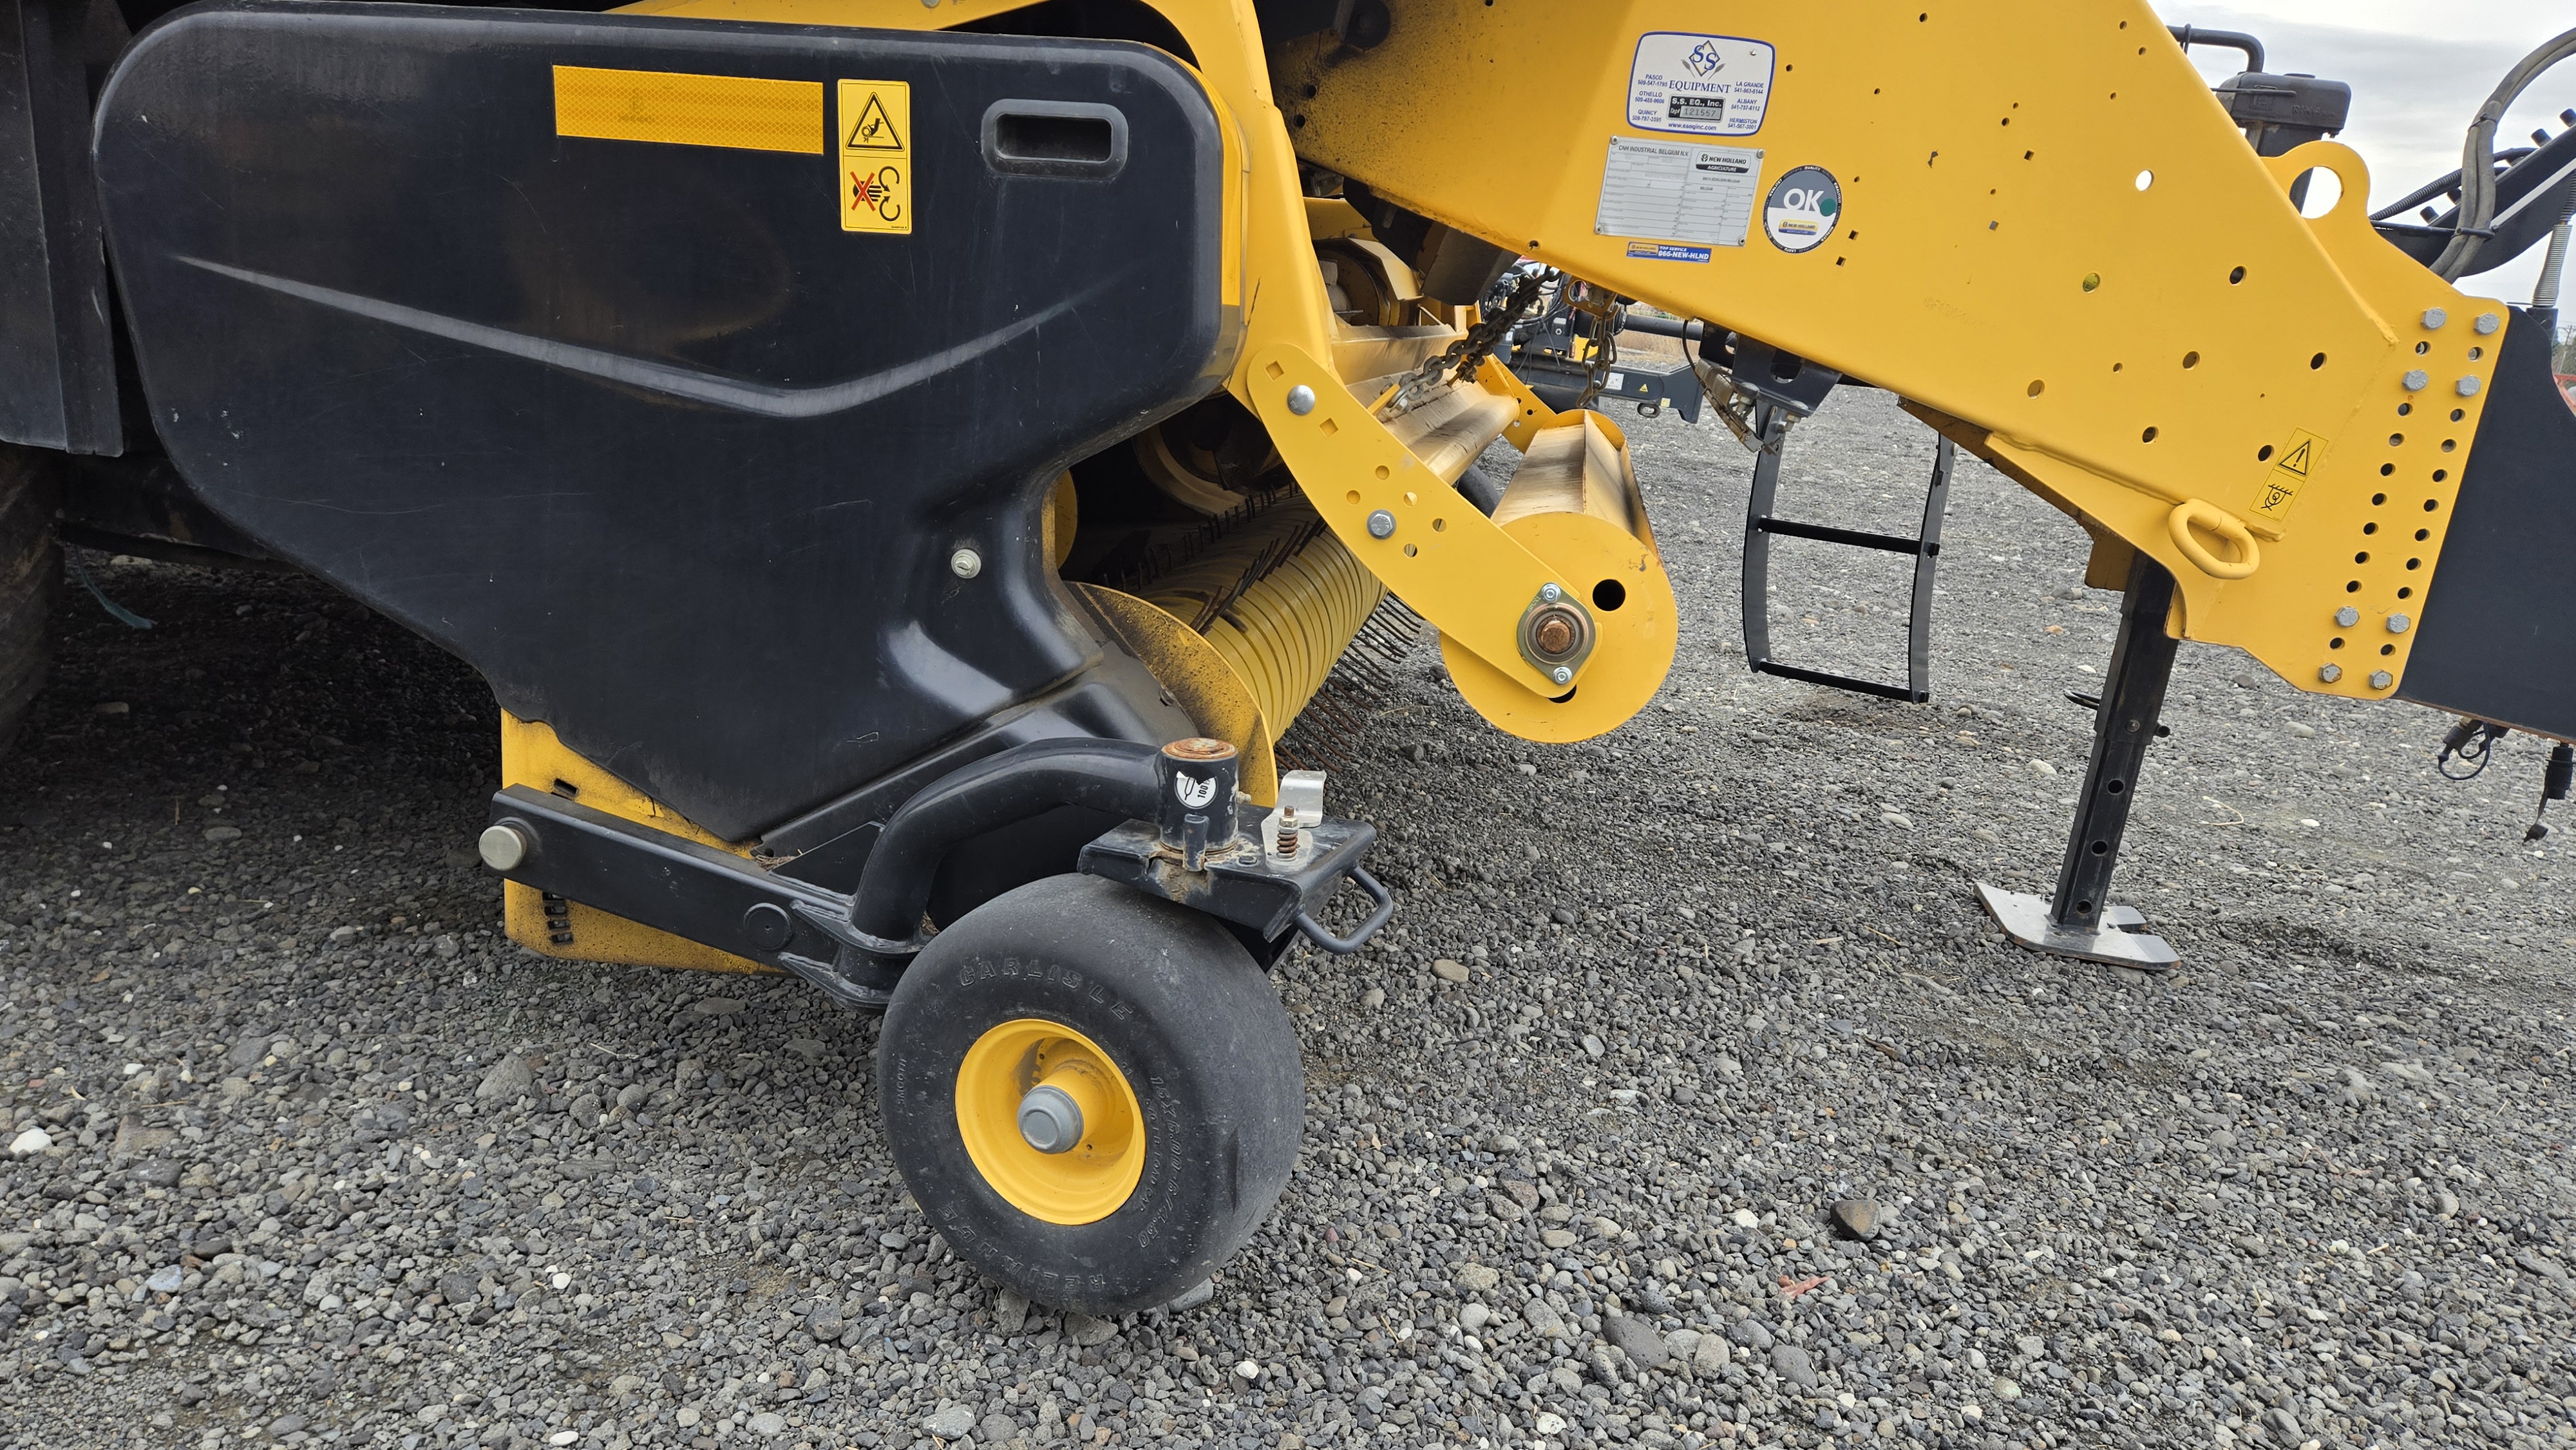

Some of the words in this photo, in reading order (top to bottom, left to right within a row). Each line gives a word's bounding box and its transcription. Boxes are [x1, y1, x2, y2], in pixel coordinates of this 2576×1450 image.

[1669, 80, 1732, 94] EQUIPMENT
[1684, 108, 1716, 117] 121557
[1783, 188, 1824, 212] OK
[1658, 250, 1709, 259] 866-NEW-HLND
[959, 957, 1133, 1021] CARLISLE
[896, 1058, 907, 1105] SMOOTH
